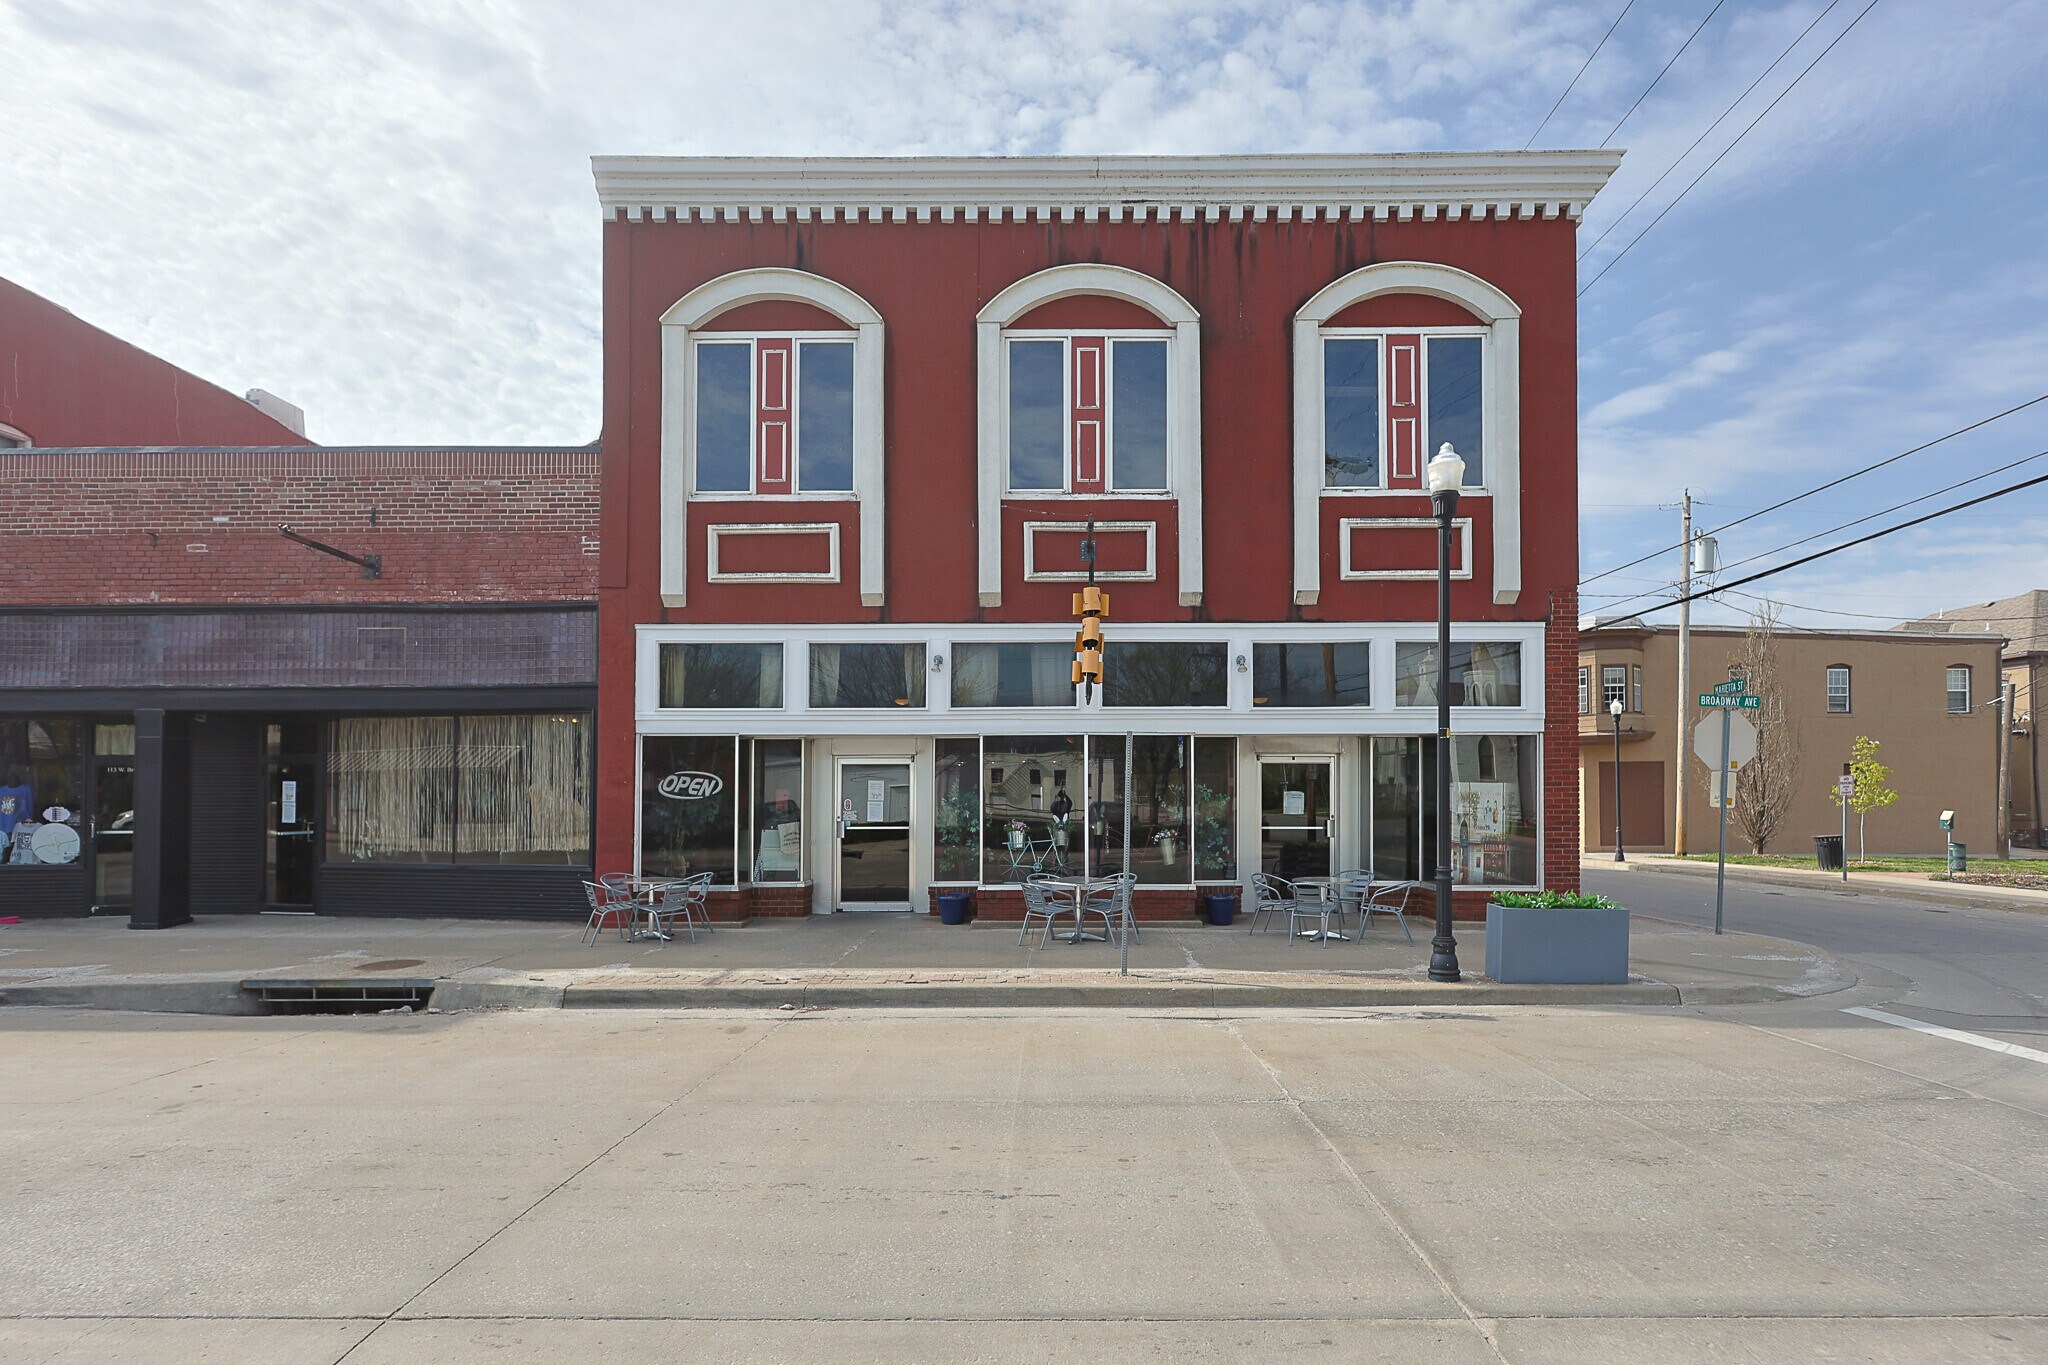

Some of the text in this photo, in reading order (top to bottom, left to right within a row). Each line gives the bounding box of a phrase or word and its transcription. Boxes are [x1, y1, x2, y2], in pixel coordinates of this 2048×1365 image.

[1714, 680, 1744, 693] MARIETTA ST
[1700, 695, 1758, 707] BROADWAY AVE
[662, 774, 716, 797] OPEN
